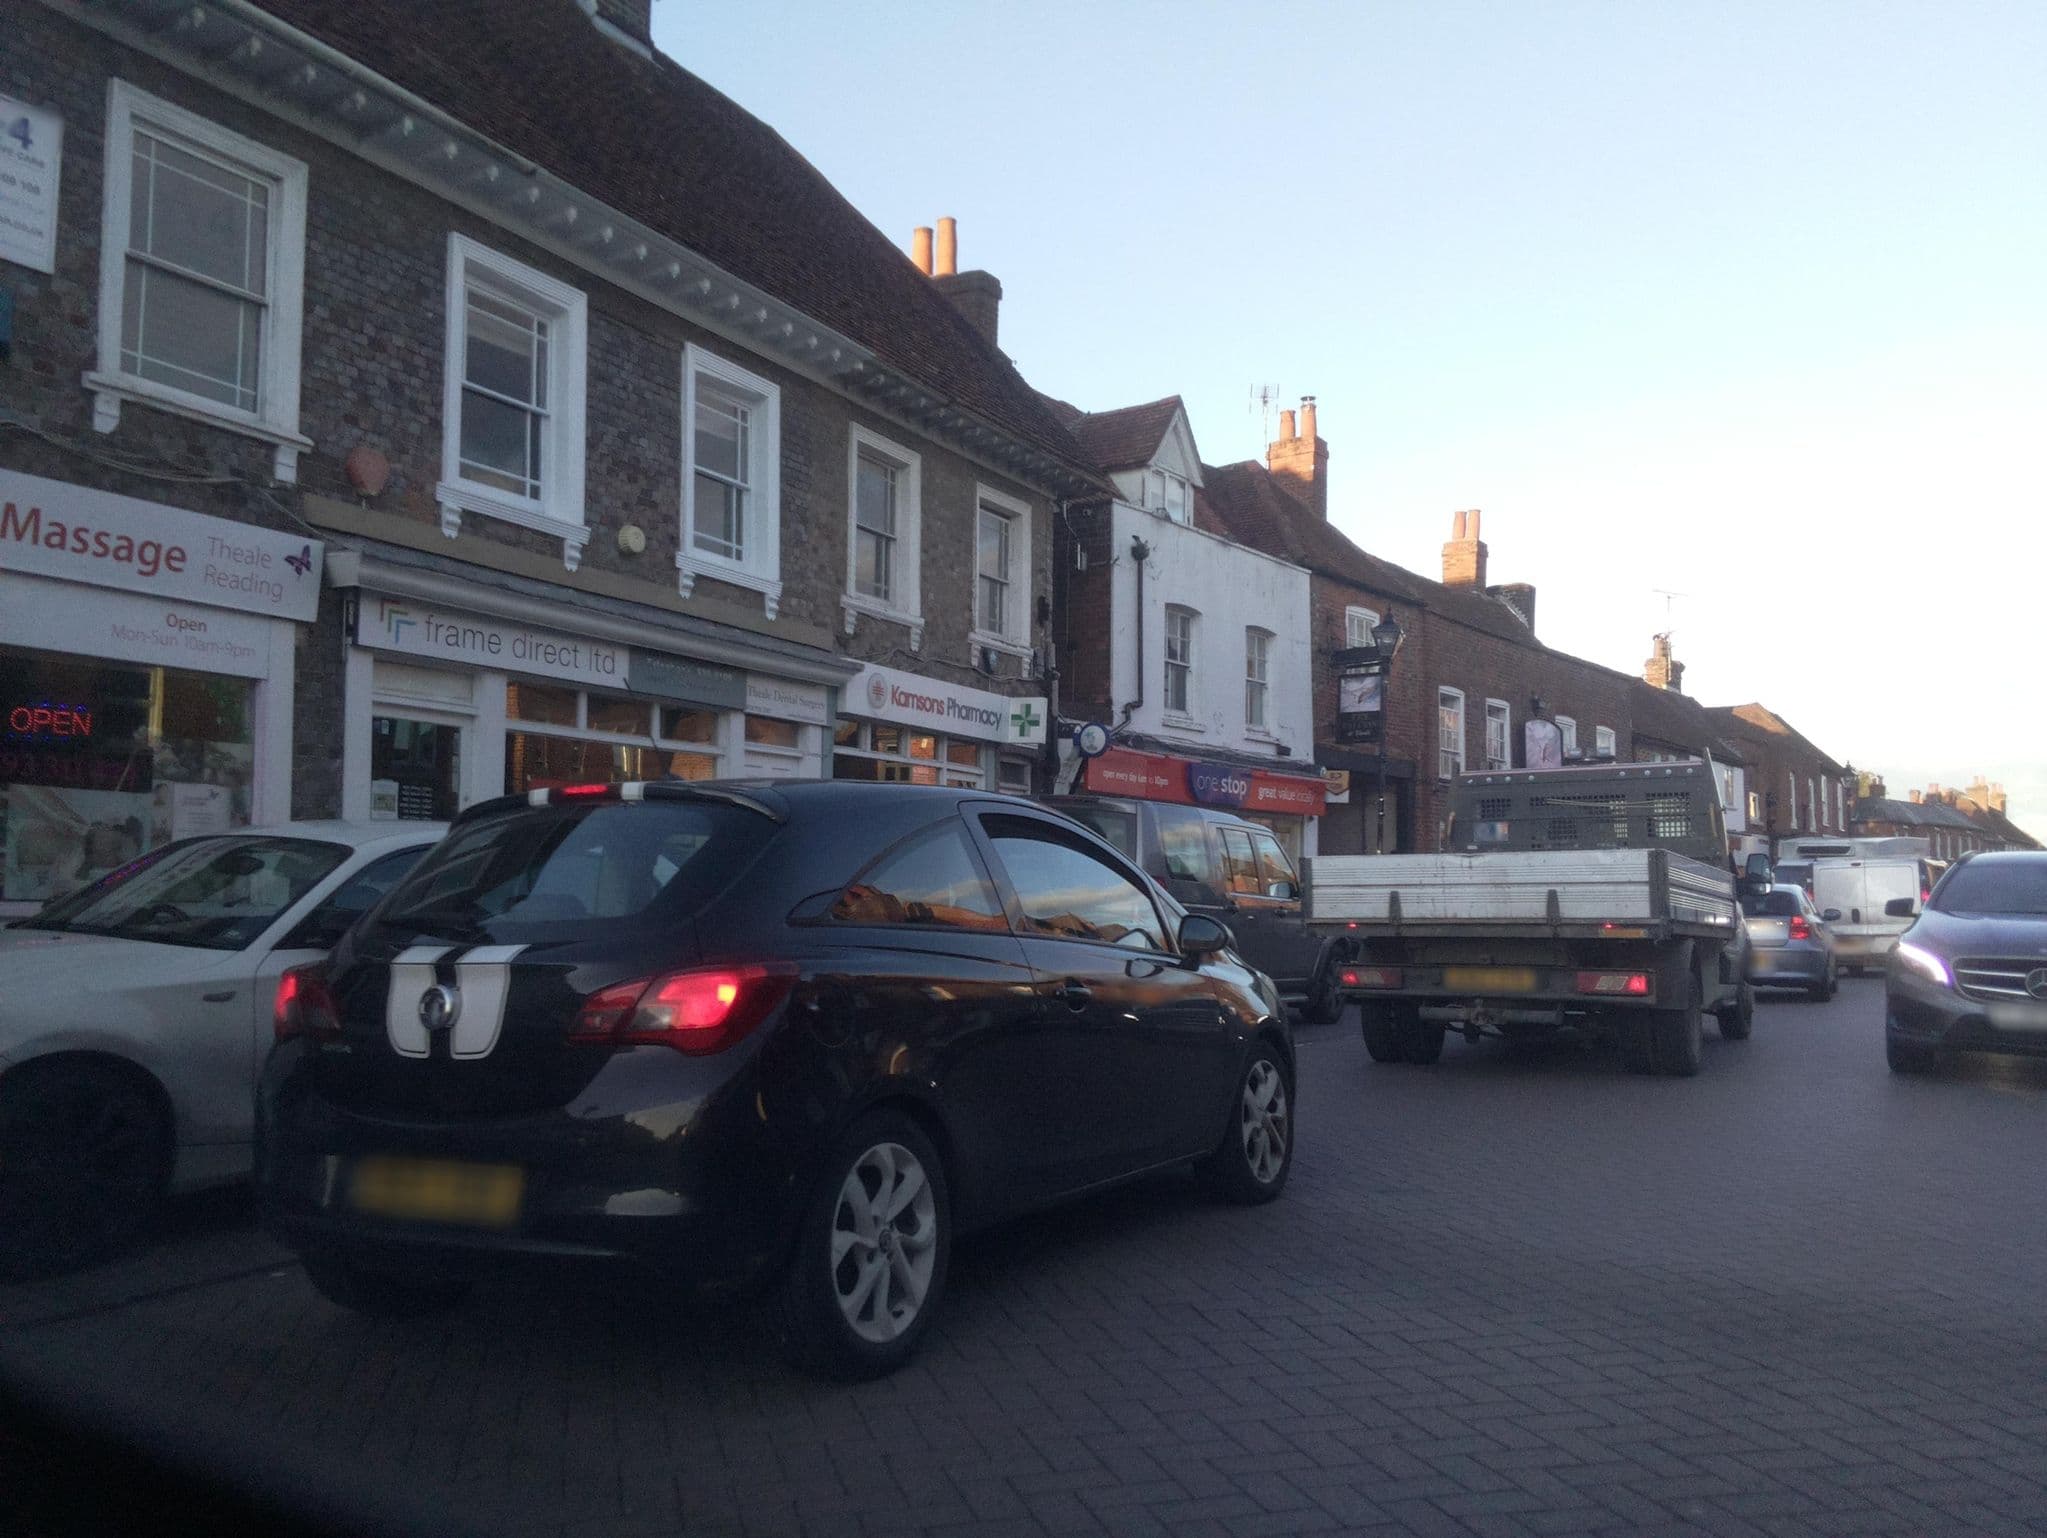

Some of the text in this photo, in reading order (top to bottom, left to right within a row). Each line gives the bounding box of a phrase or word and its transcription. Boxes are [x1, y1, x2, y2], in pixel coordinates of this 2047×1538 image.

[0, 501, 187, 577] Massage
[207, 536, 273, 569] Theale
[204, 564, 284, 603] Reading
[111, 624, 179, 648] Mon-Sun
[166, 613, 207, 633] Open
[425, 614, 502, 655] frame
[512, 632, 579, 669] direct
[588, 642, 616, 675] ltd
[10, 706, 92, 736] OPEN
[891, 684, 1002, 732] Kamsons Pharmacy
[1196, 774, 1247, 800] one stop
[1257, 786, 1278, 801] great
[1278, 787, 1296, 801] value
